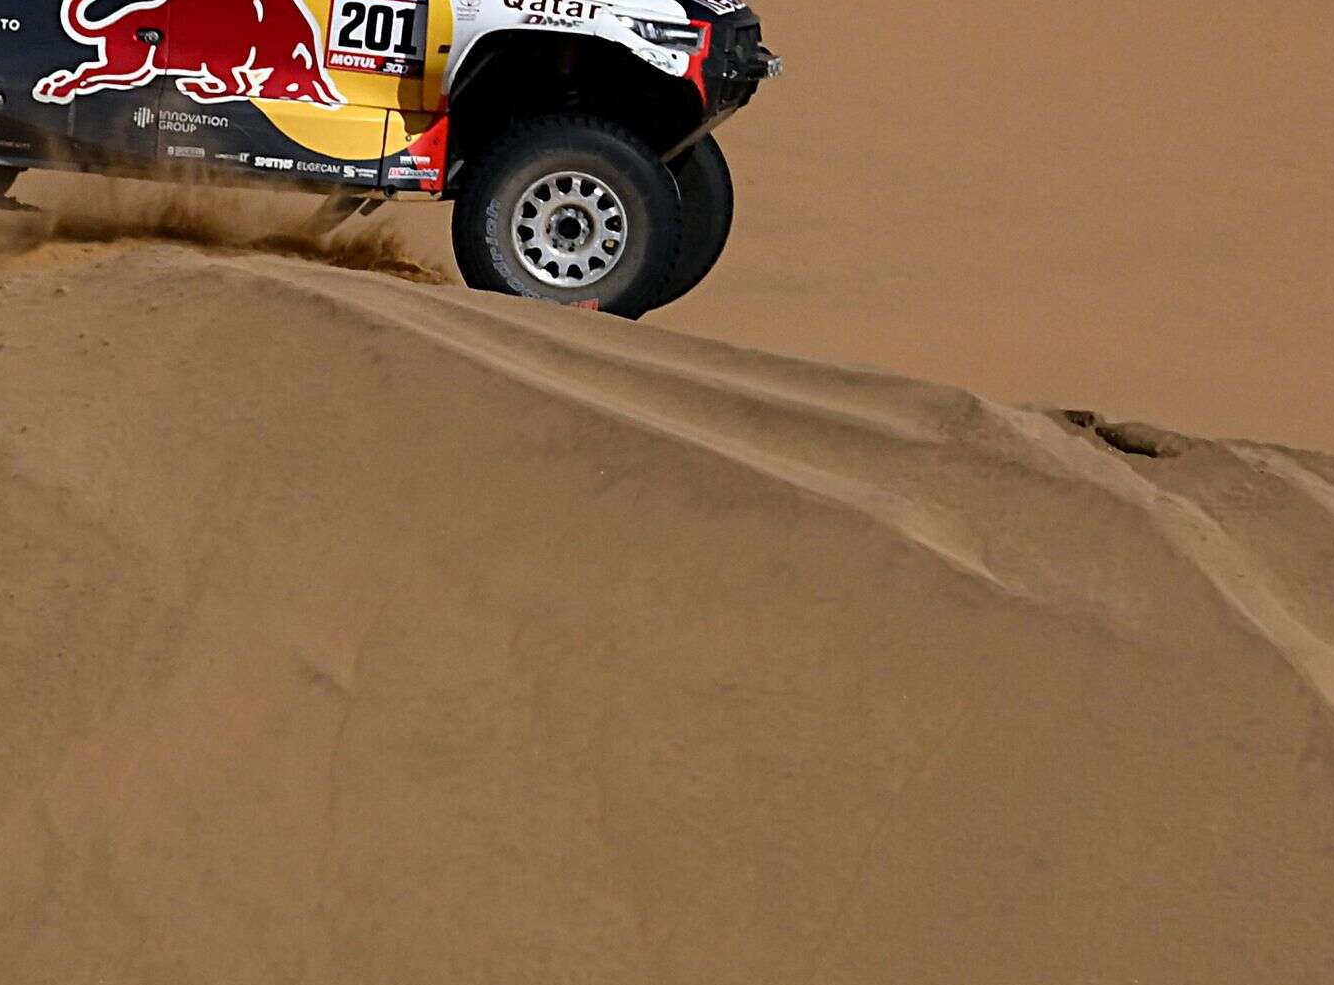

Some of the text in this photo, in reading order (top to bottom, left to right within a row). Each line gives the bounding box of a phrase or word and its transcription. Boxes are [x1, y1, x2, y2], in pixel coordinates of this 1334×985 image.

[338, 1, 417, 55] 201
[330, 53, 377, 69] MOTUL
[158, 120, 198, 134] GROUP
